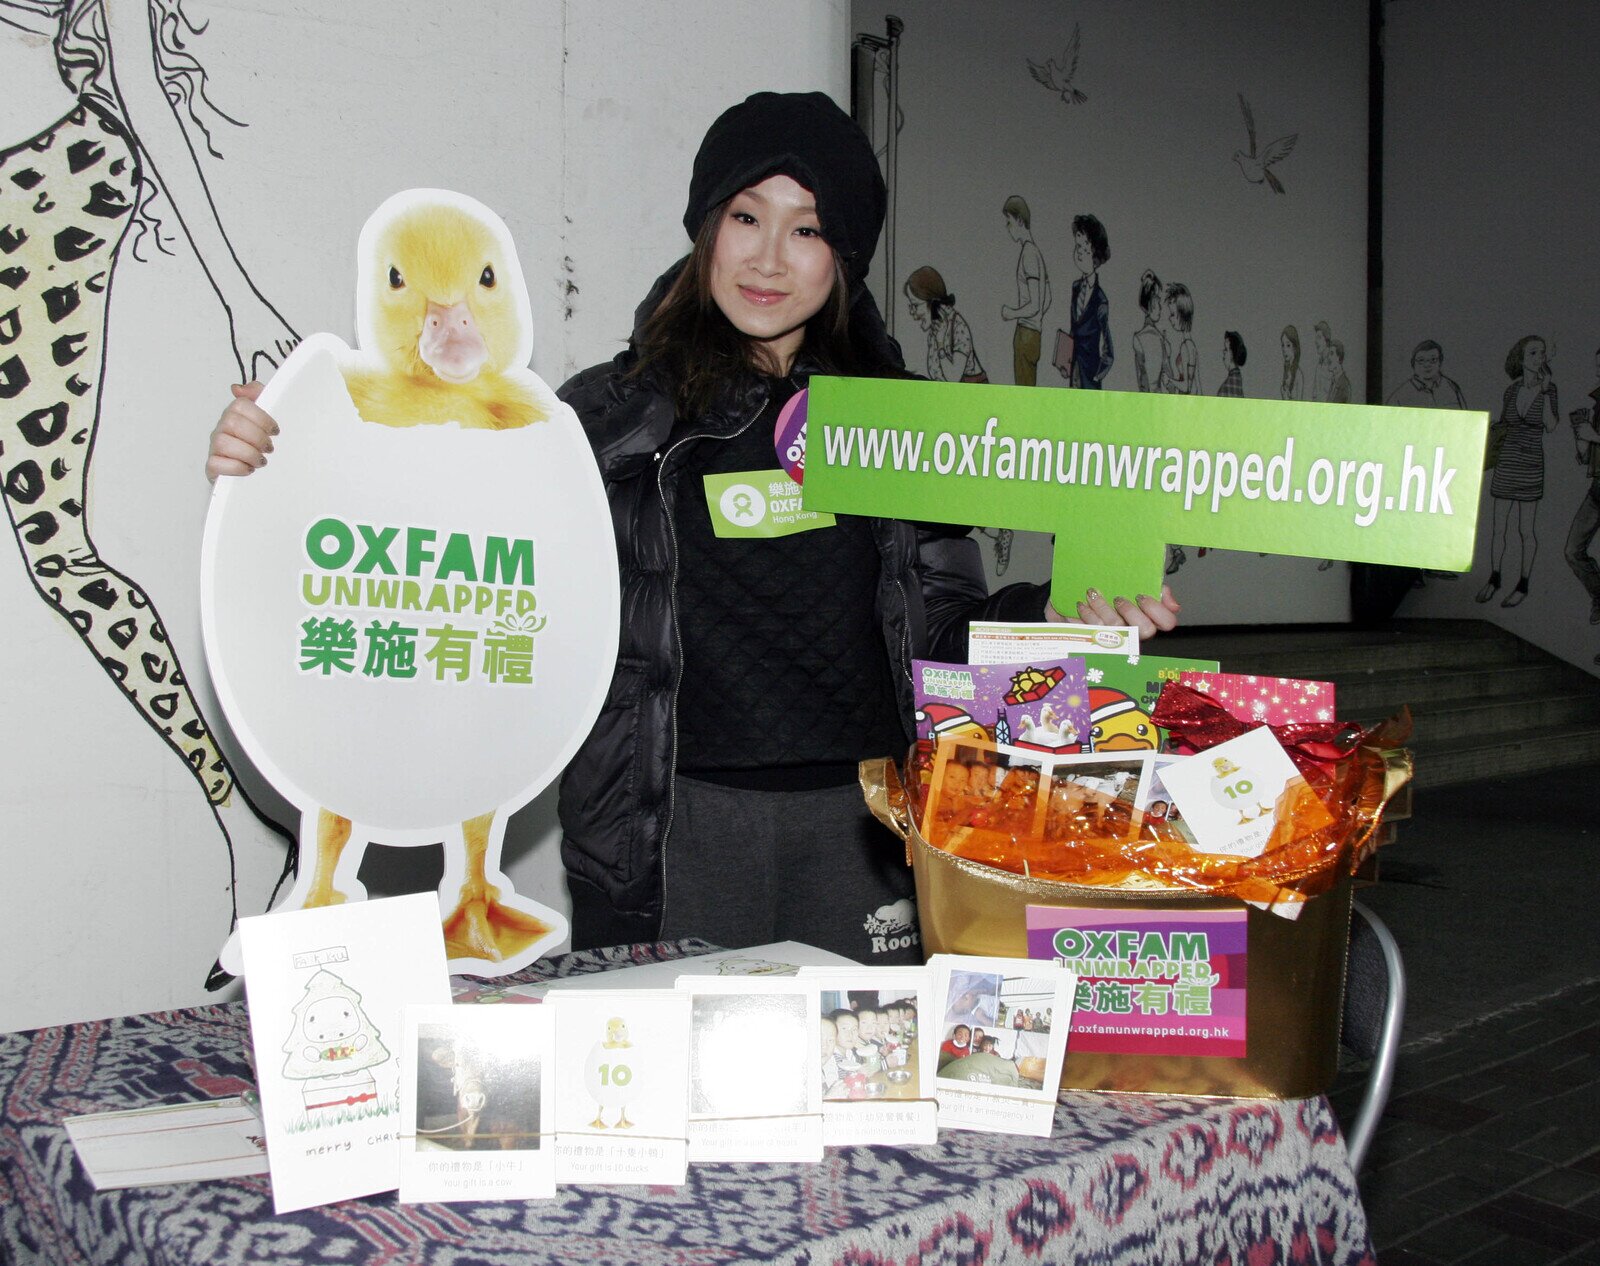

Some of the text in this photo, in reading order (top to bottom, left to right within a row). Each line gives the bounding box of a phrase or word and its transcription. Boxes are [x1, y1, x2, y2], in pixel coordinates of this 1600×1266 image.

[823, 417, 1457, 528] www.oxfamunwrapped.org.hk
[773, 511, 818, 524] Hong Kong
[305, 517, 535, 587] OXFAM
[302, 573, 537, 616] UNWRAPPED
[299, 616, 535, 684] 樂施有禮
[924, 668, 971, 681] OXFAM
[1224, 780, 1253, 799] 10
[1054, 929, 1209, 960] OXFAM
[598, 1063, 632, 1087] 10
[985, 1109, 1023, 1121] emergency
[306, 1141, 351, 1156] merry
[571, 1161, 587, 1171] Your
[589, 1162, 603, 1173] gift
[604, 1162, 612, 1171] is
[625, 1163, 649, 1172] ducks
[443, 1178, 460, 1187] Your
[463, 1178, 477, 1189] gift
[495, 1179, 513, 1187] cow
